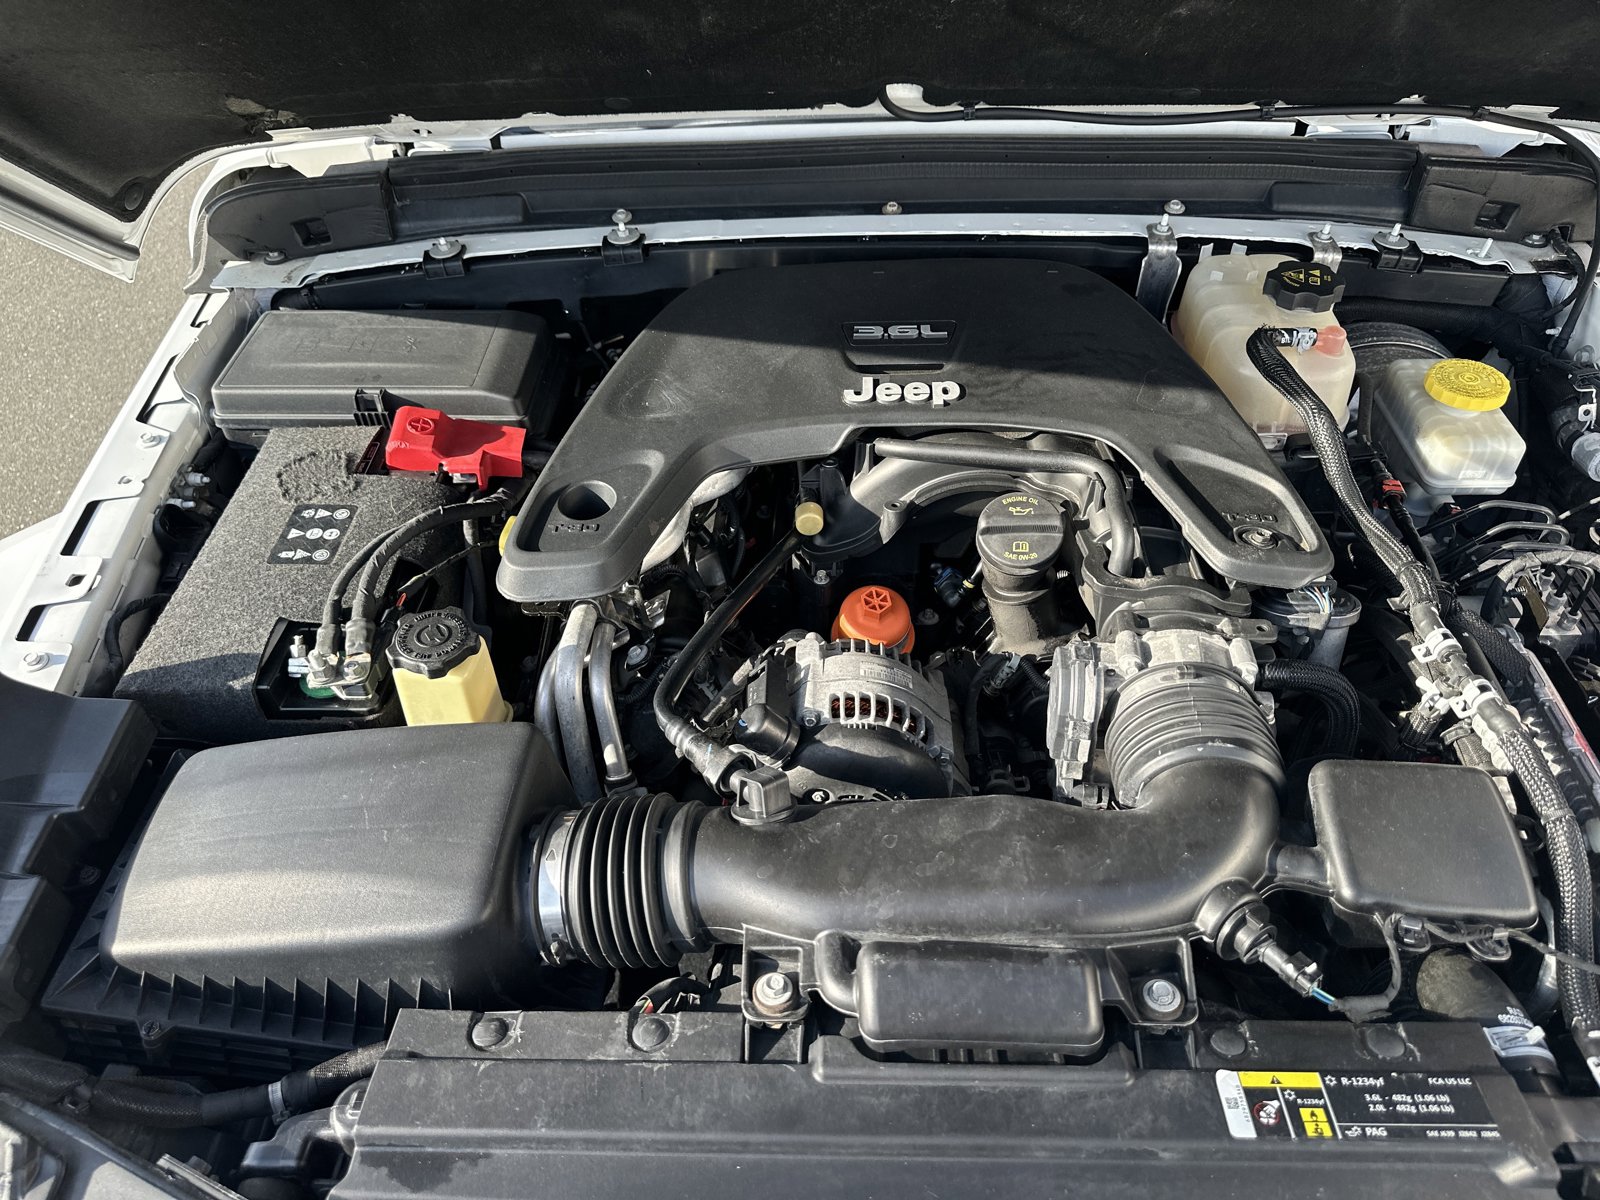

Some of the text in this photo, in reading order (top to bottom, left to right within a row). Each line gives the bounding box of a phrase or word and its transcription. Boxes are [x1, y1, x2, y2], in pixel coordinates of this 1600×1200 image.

[853, 324, 948, 339] 3.6L
[842, 376, 962, 409] Jeep
[1002, 496, 1039, 506] ENGINE OIL
[1003, 551, 1038, 561] SAE 0W-20
[1340, 1076, 1385, 1089] R-1234yf
[1427, 1077, 1473, 1086] FCA US LLC
[1296, 1098, 1325, 1106] R-1234yf
[1364, 1093, 1382, 1102] 3.6L
[1392, 1094, 1413, 1103] 482g
[1415, 1093, 1436, 1103] (1.06
[1437, 1094, 1451, 1103] Lb)
[1368, 1104, 1387, 1112] 2.0L
[1396, 1104, 1417, 1114] 482g
[1419, 1104, 1440, 1114] (1.06
[1441, 1105, 1455, 1114] Lb)
[1365, 1127, 1388, 1137] PAG
